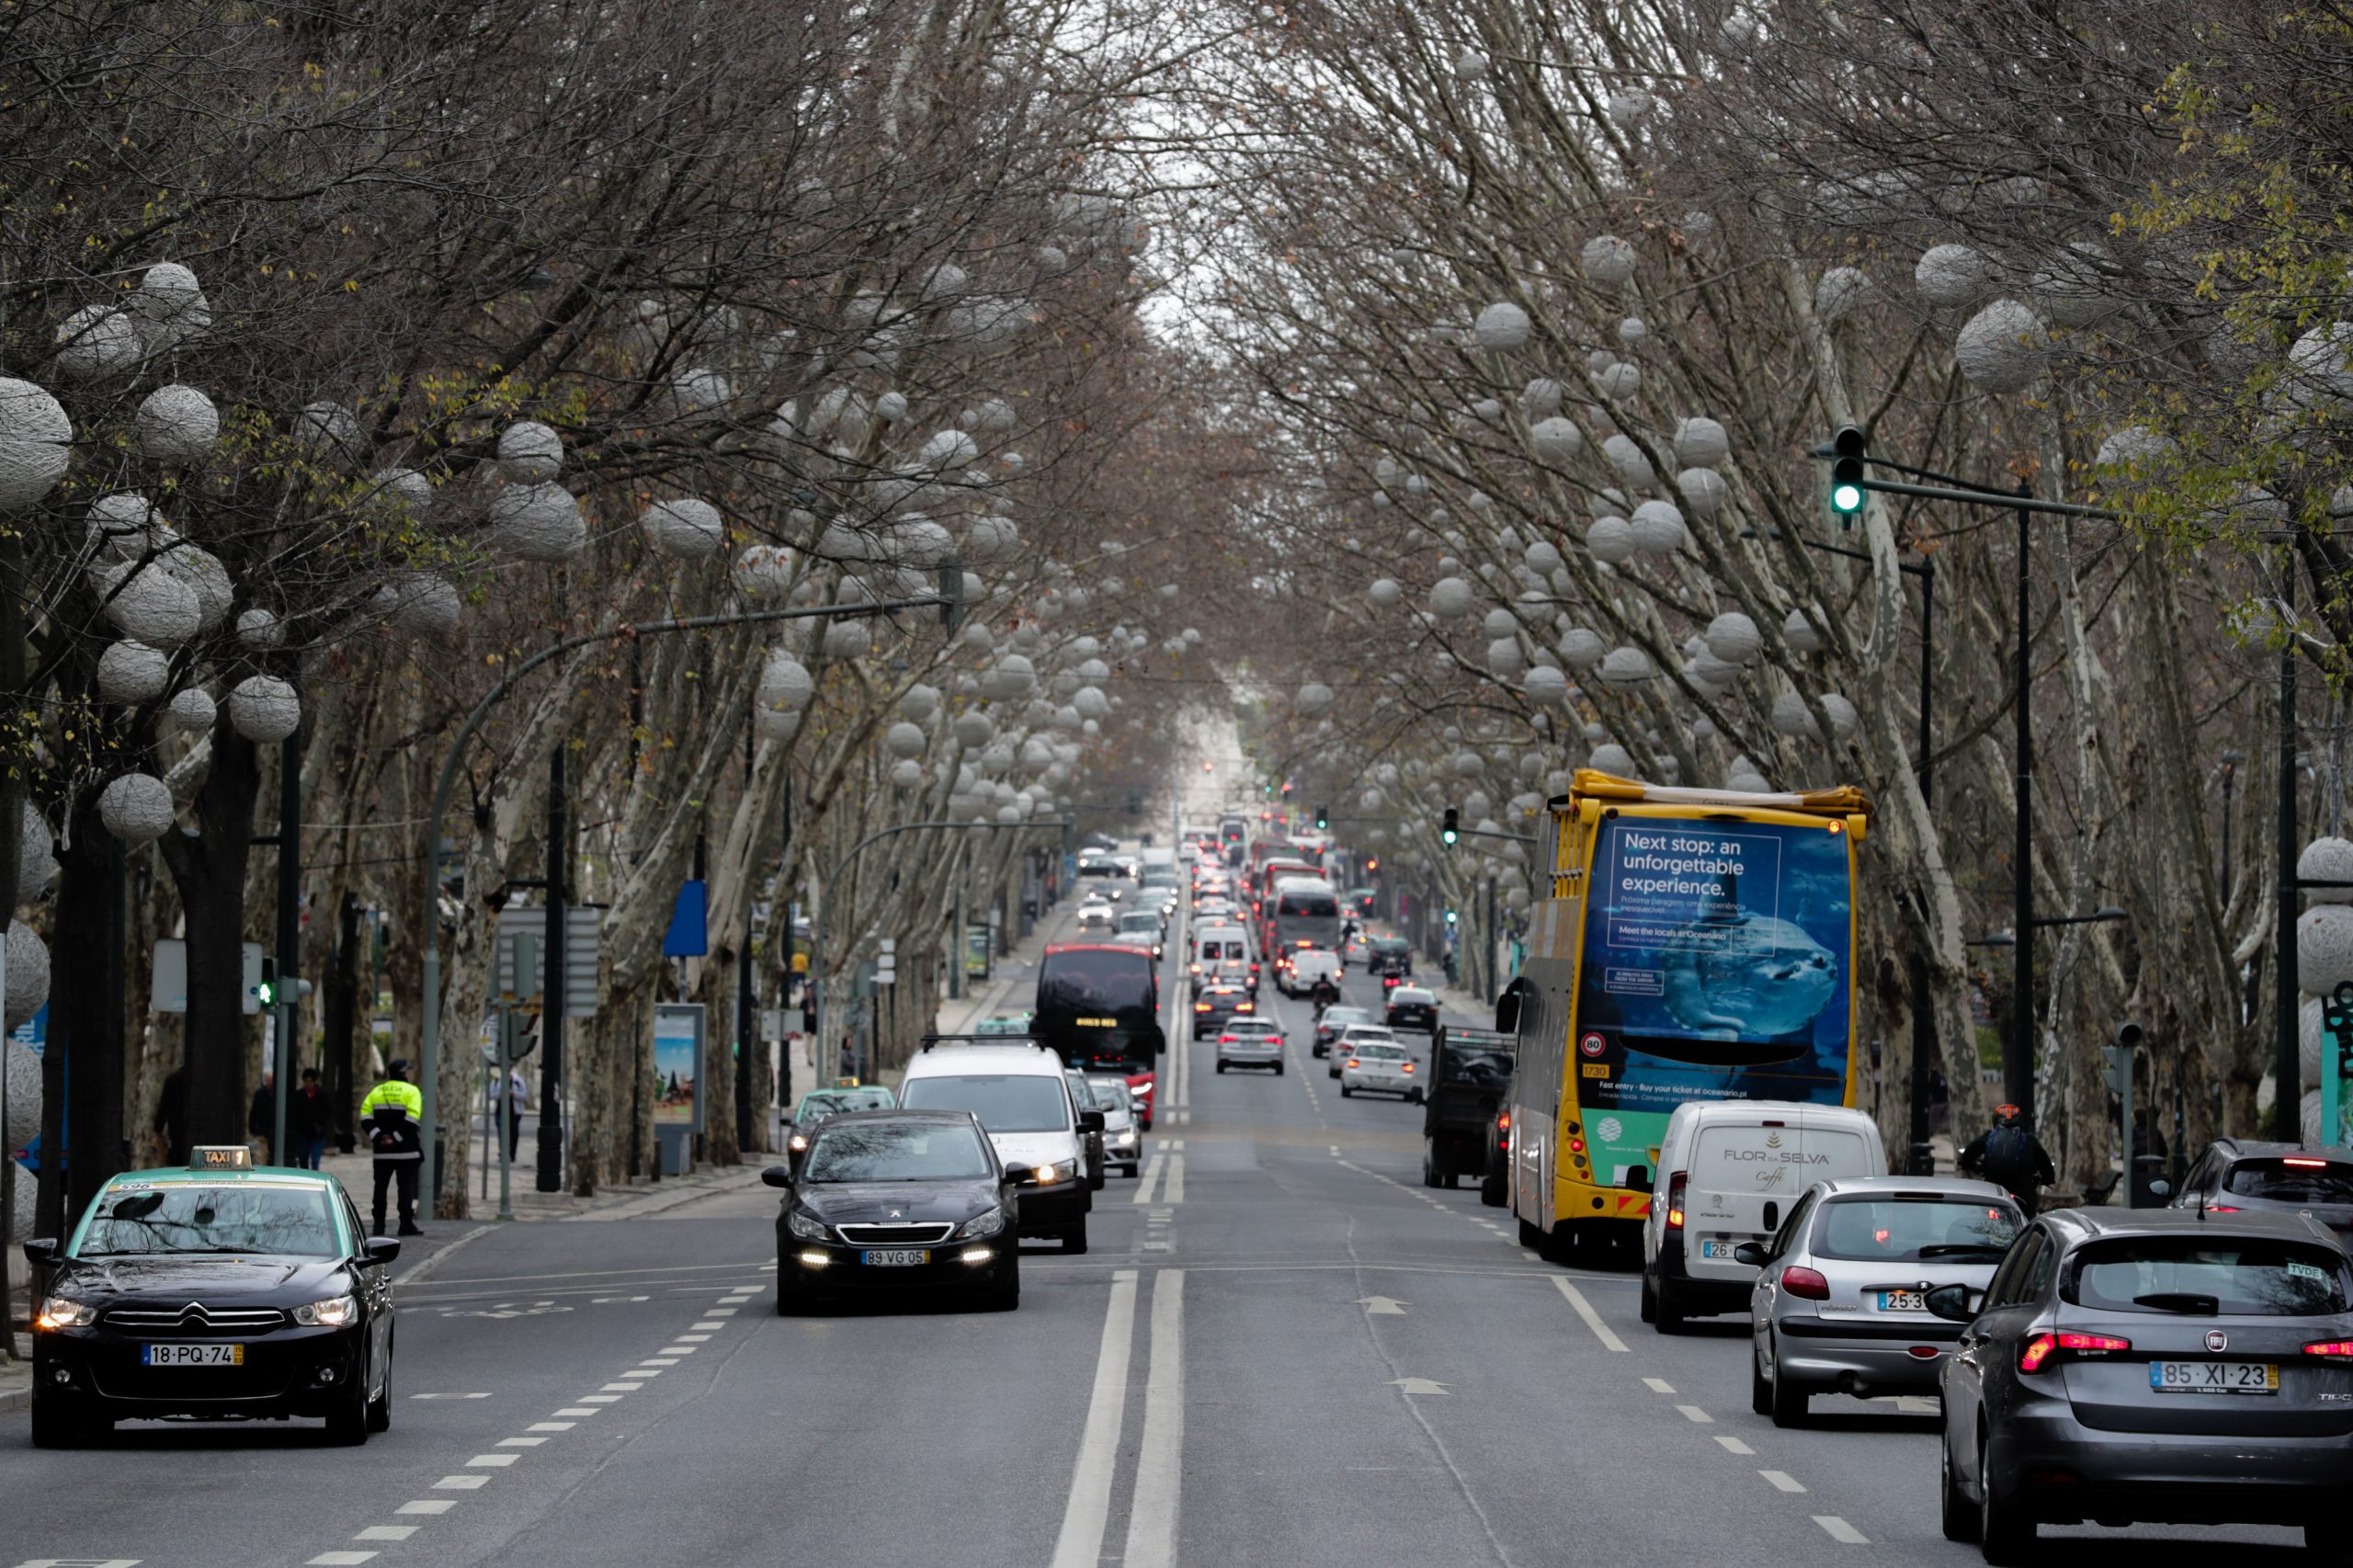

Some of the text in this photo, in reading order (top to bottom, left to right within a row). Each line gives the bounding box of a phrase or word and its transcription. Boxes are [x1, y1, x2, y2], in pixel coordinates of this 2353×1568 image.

[1625, 833, 1741, 856] Next stop: an
[1623, 854, 1745, 875] unforgettable
[1622, 878, 1725, 896] experience.
[1620, 895, 1650, 904] Próxima
[1705, 902, 1745, 911] experiência
[1619, 926, 1639, 935] Meet
[1641, 926, 1654, 936] the
[1654, 927, 1676, 937] locals
[1677, 929, 1686, 937] at
[1686, 929, 1726, 940] Oceanário
[1586, 1040, 1600, 1050] 80
[1585, 1066, 1606, 1076] 1730
[1599, 1081, 1613, 1089] Fast
[1615, 1083, 1634, 1092] entry
[1639, 1084, 1654, 1093] Buy
[1654, 1086, 1671, 1095] your
[1672, 1085, 1692, 1094] ticket
[1702, 1089, 1748, 1098] oceanario.pt
[204, 1151, 231, 1163] TAXI
[1724, 1150, 1767, 1162] FLOR
[1780, 1153, 1830, 1165] SELVA
[2290, 1265, 2320, 1278] TVDE
[2210, 1335, 2223, 1347] FIAT
